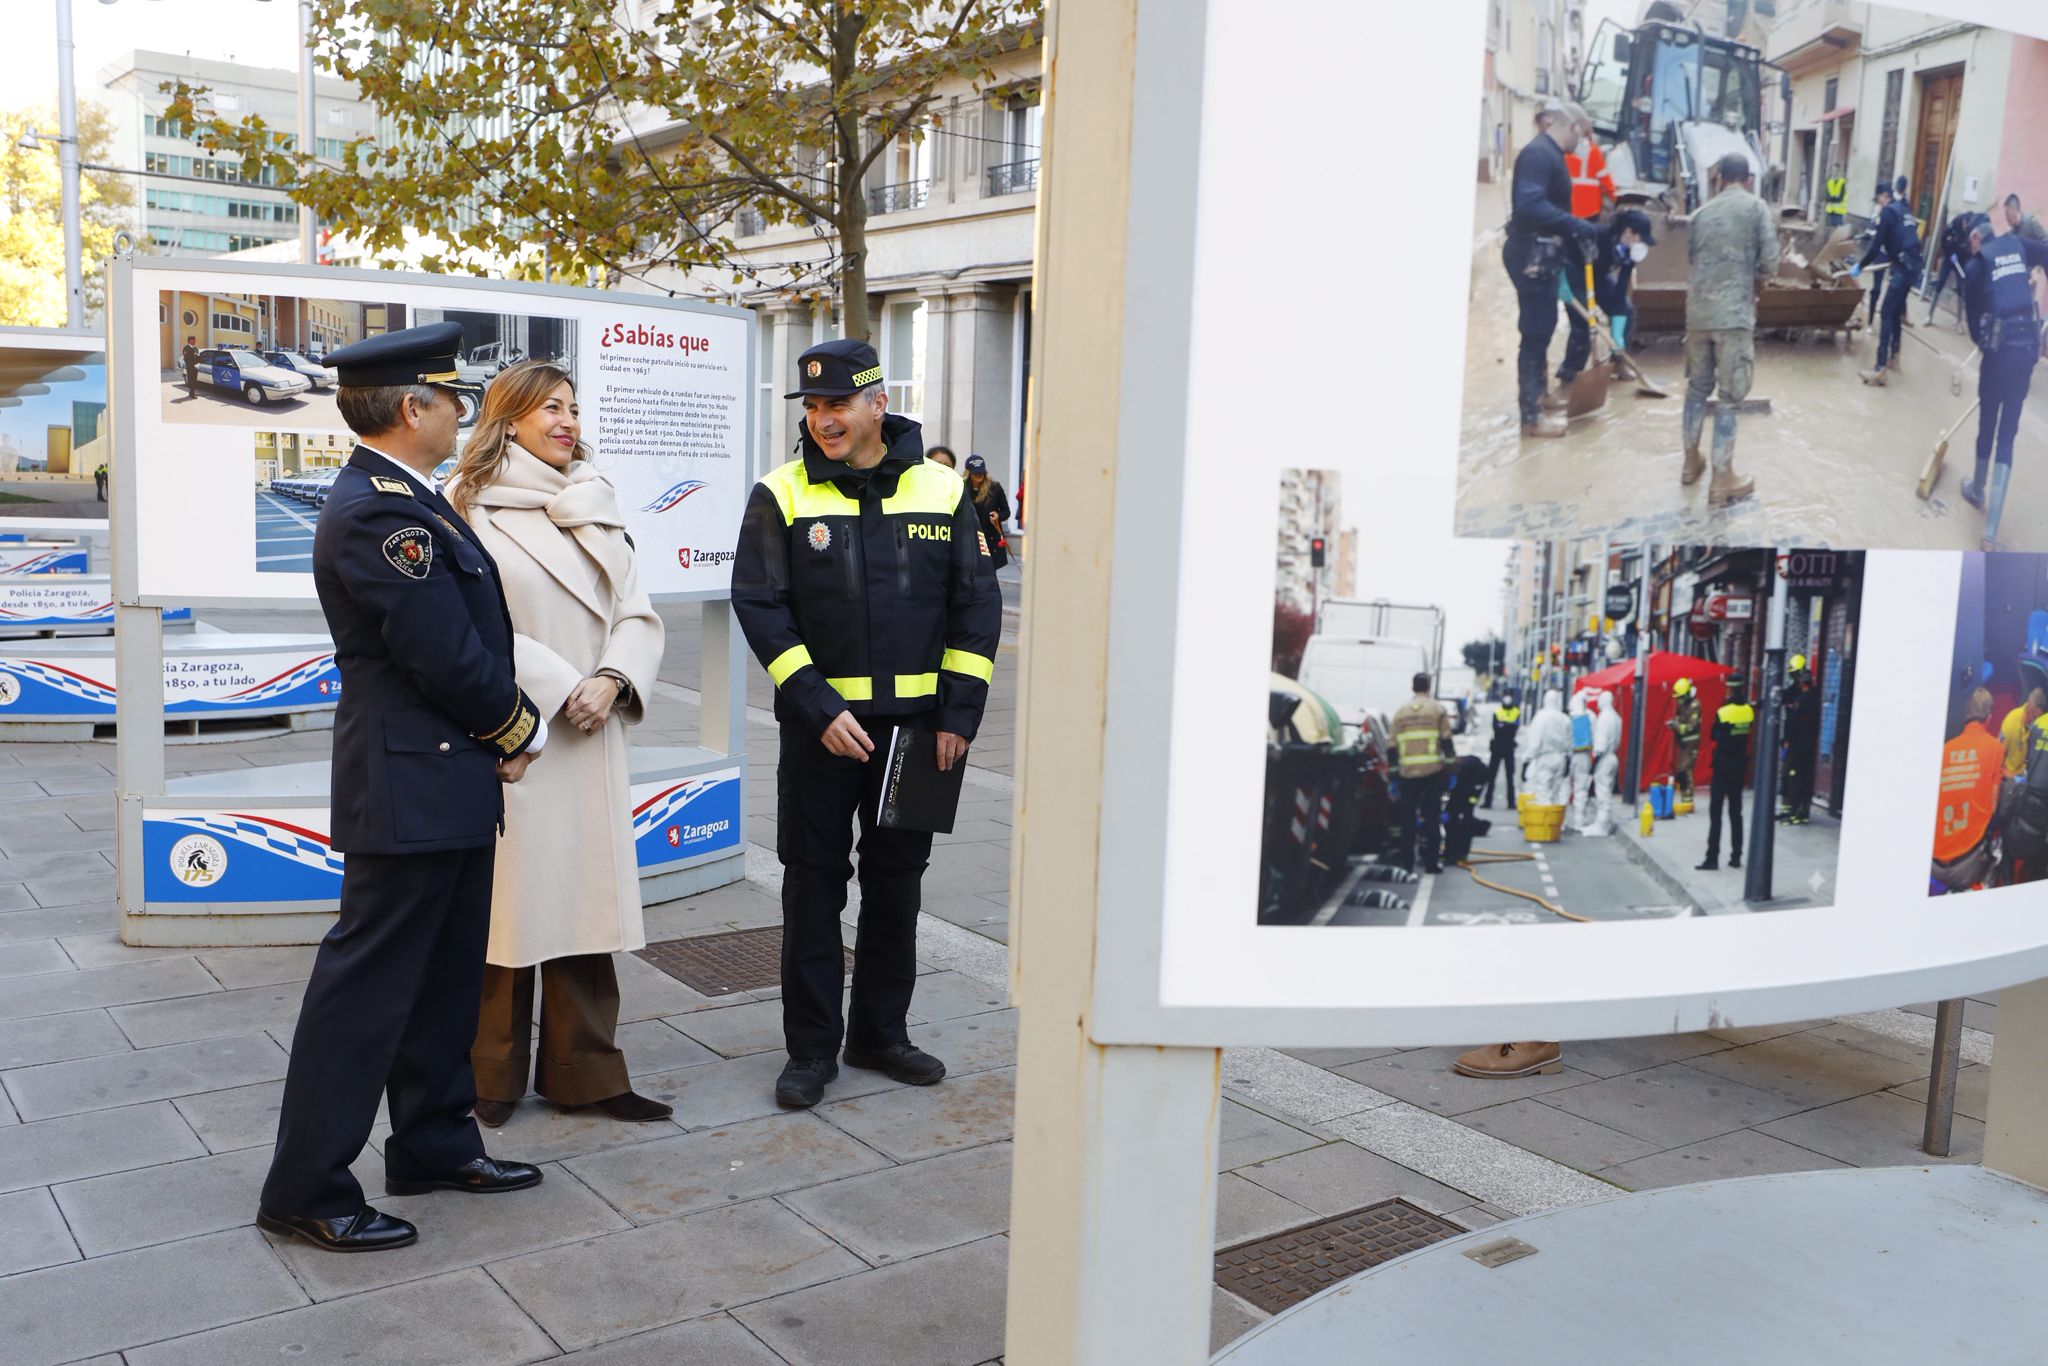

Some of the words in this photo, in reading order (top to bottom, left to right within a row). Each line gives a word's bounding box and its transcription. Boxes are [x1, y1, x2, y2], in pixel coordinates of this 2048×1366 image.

[601, 323, 674, 348] ¿Sabías
[679, 335, 709, 357] que
[609, 354, 631, 363] primer
[632, 356, 650, 364] coche
[650, 358, 674, 367] patrulla
[600, 363, 622, 372] ciudad
[606, 384, 612, 392] El
[613, 385, 635, 395] primer
[675, 390, 693, 399] ruedas
[599, 396, 612, 404] que
[642, 397, 659, 406] hasta
[660, 398, 679, 407] finales
[679, 400, 687, 408] de
[687, 400, 695, 408] los
[599, 406, 641, 415] motocicletas
[642, 409, 647, 417] y
[647, 408, 684, 418] ciclomotores
[684, 410, 700, 419] desde
[700, 411, 708, 419] los
[599, 415, 608, 423] En
[609, 416, 626, 425] 1966
[634, 417, 669, 427] adquirieron
[680, 421, 713, 430] motocicletas
[599, 426, 629, 436] (Sanglas)
[629, 429, 634, 437] y
[644, 428, 658, 436] Seat
[675, 430, 692, 438] Desde
[621, 438, 647, 446] contaba
[659, 439, 682, 447] decenas
[682, 440, 689, 448] de
[599, 447, 633, 456] actualidad
[907, 523, 952, 542] POLICI
[387, 530, 425, 549] ZARAGOZA
[693, 549, 735, 566] Zaragoza
[44, 589, 91, 599] Zaragoza,
[1, 600, 29, 608] desde
[33, 600, 58, 610] 1850,
[79, 599, 100, 608] lado
[181, 662, 244, 675] Zaragoza,
[165, 678, 199, 690] 1850,
[202, 679, 210, 687] a
[213, 677, 227, 687] tu
[230, 675, 256, 686] lado
[683, 819, 729, 839] Zaragoza
[183, 869, 214, 882] 175
